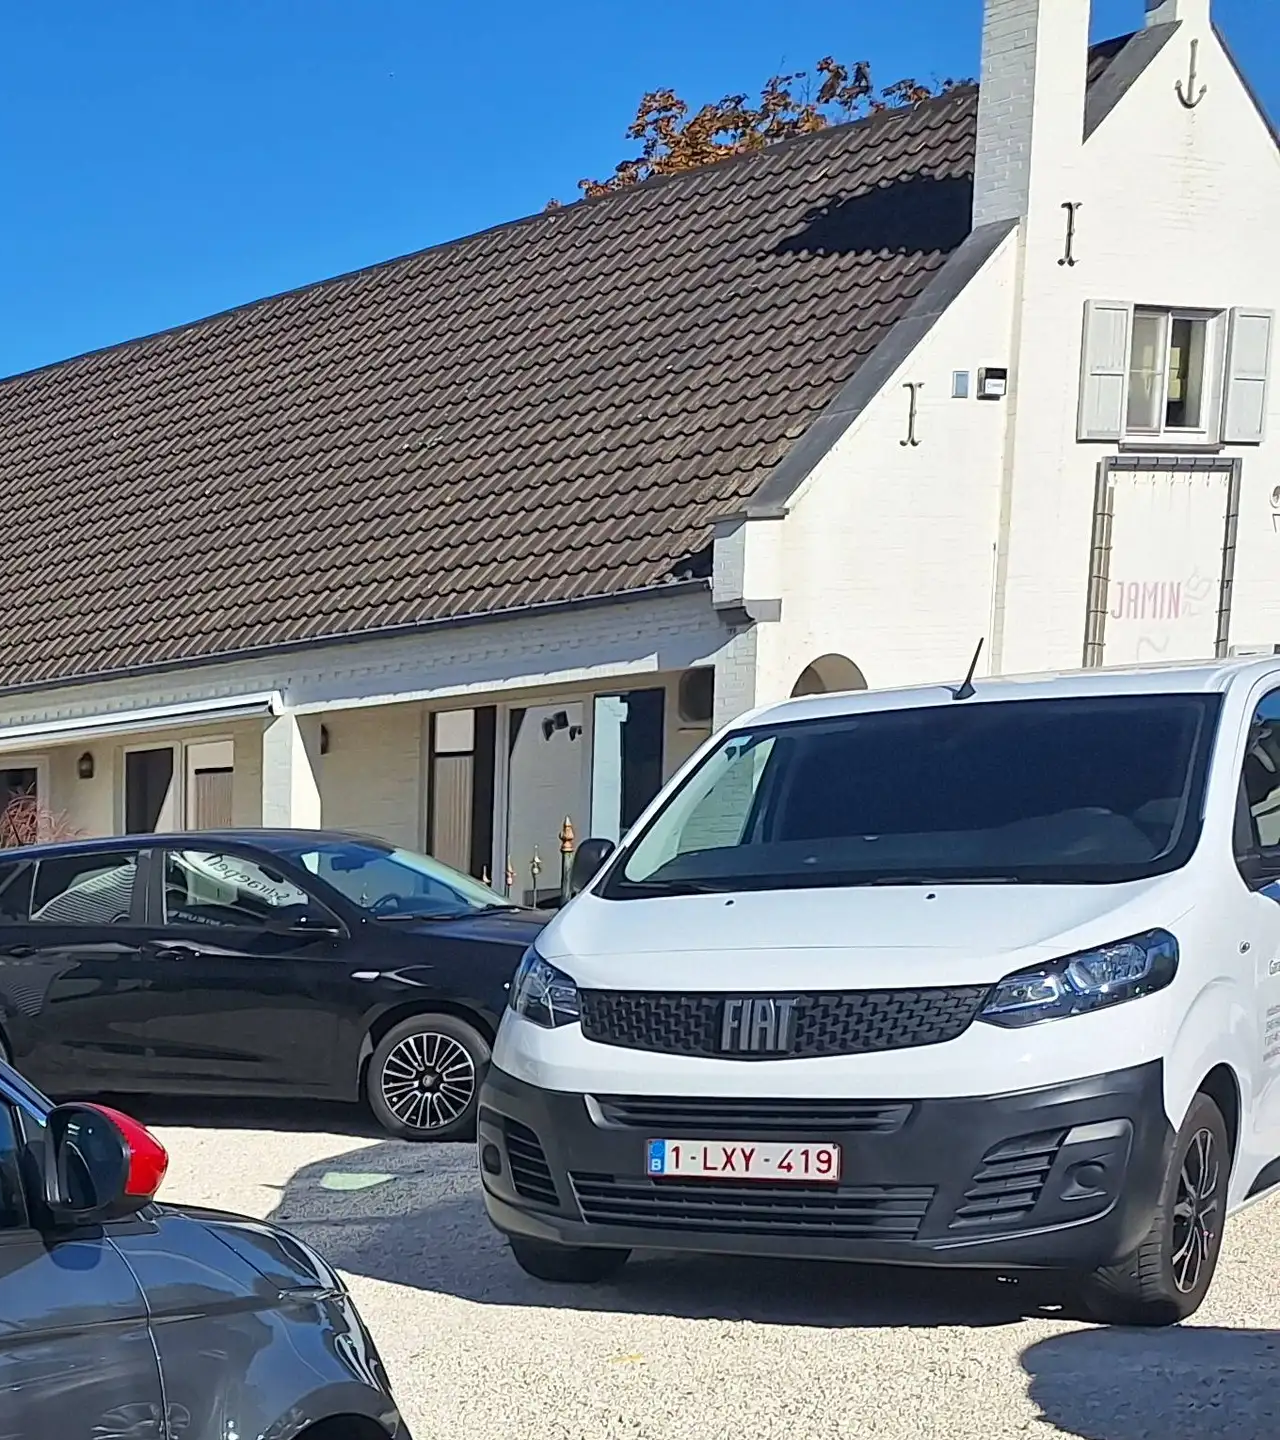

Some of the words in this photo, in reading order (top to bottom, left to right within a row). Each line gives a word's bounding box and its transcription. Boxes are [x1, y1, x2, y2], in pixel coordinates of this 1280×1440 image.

[1111, 580, 1181, 620] JAMIN
[721, 998, 798, 1050] FIAT
[650, 1159, 661, 1171] B
